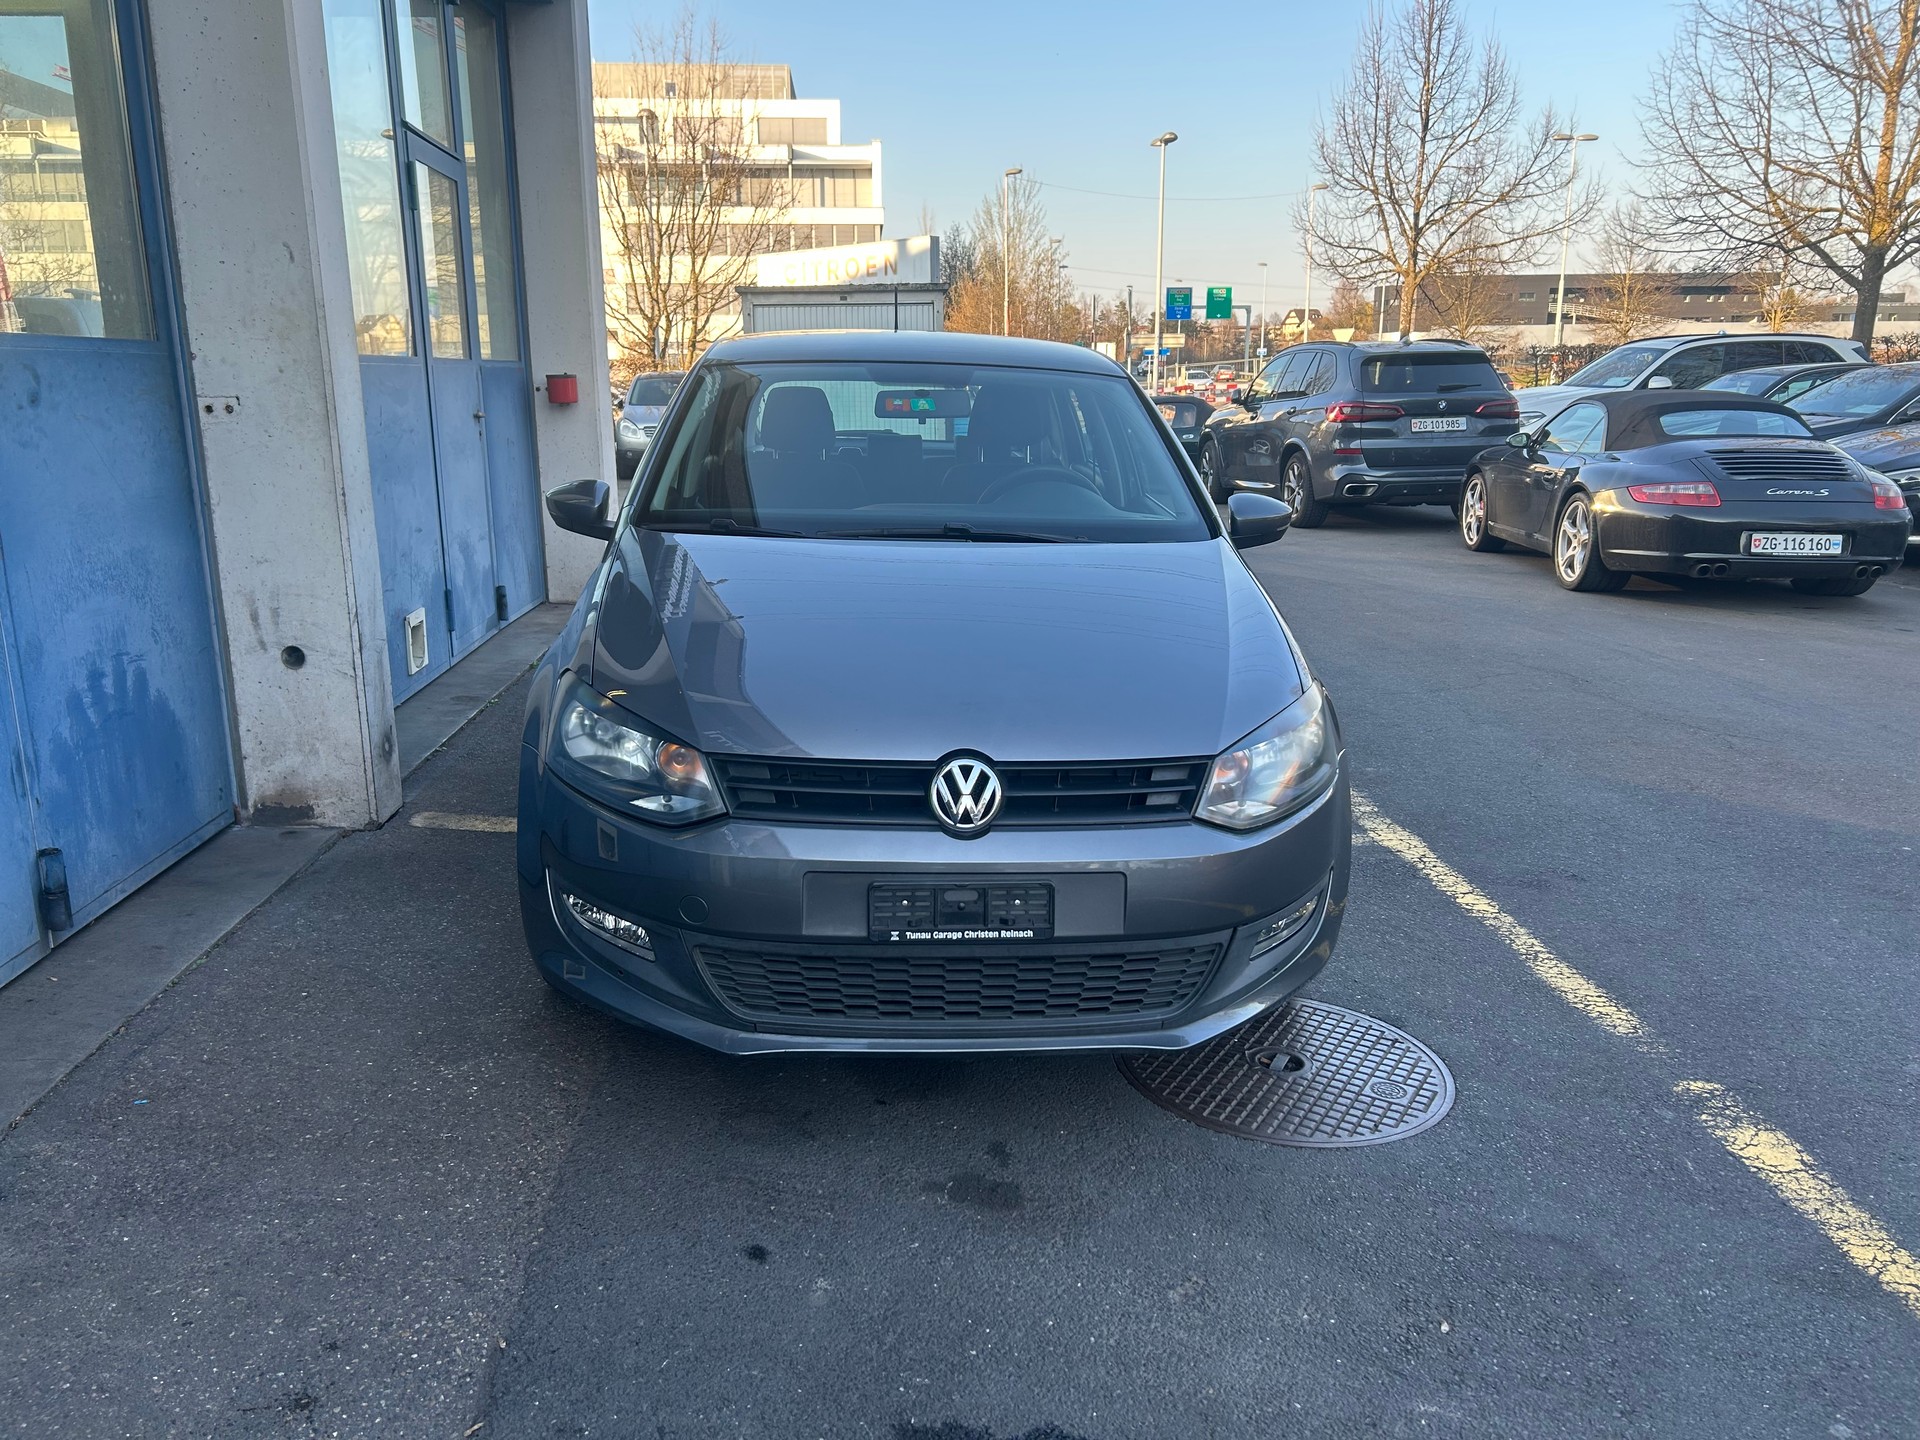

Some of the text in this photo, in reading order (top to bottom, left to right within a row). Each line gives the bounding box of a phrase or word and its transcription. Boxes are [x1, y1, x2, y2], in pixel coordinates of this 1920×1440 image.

[784, 253, 899, 284] CITROEN
[1766, 487, 1830, 496] Carrera S
[905, 929, 1034, 940] Tunau Garage Christen Reinach
